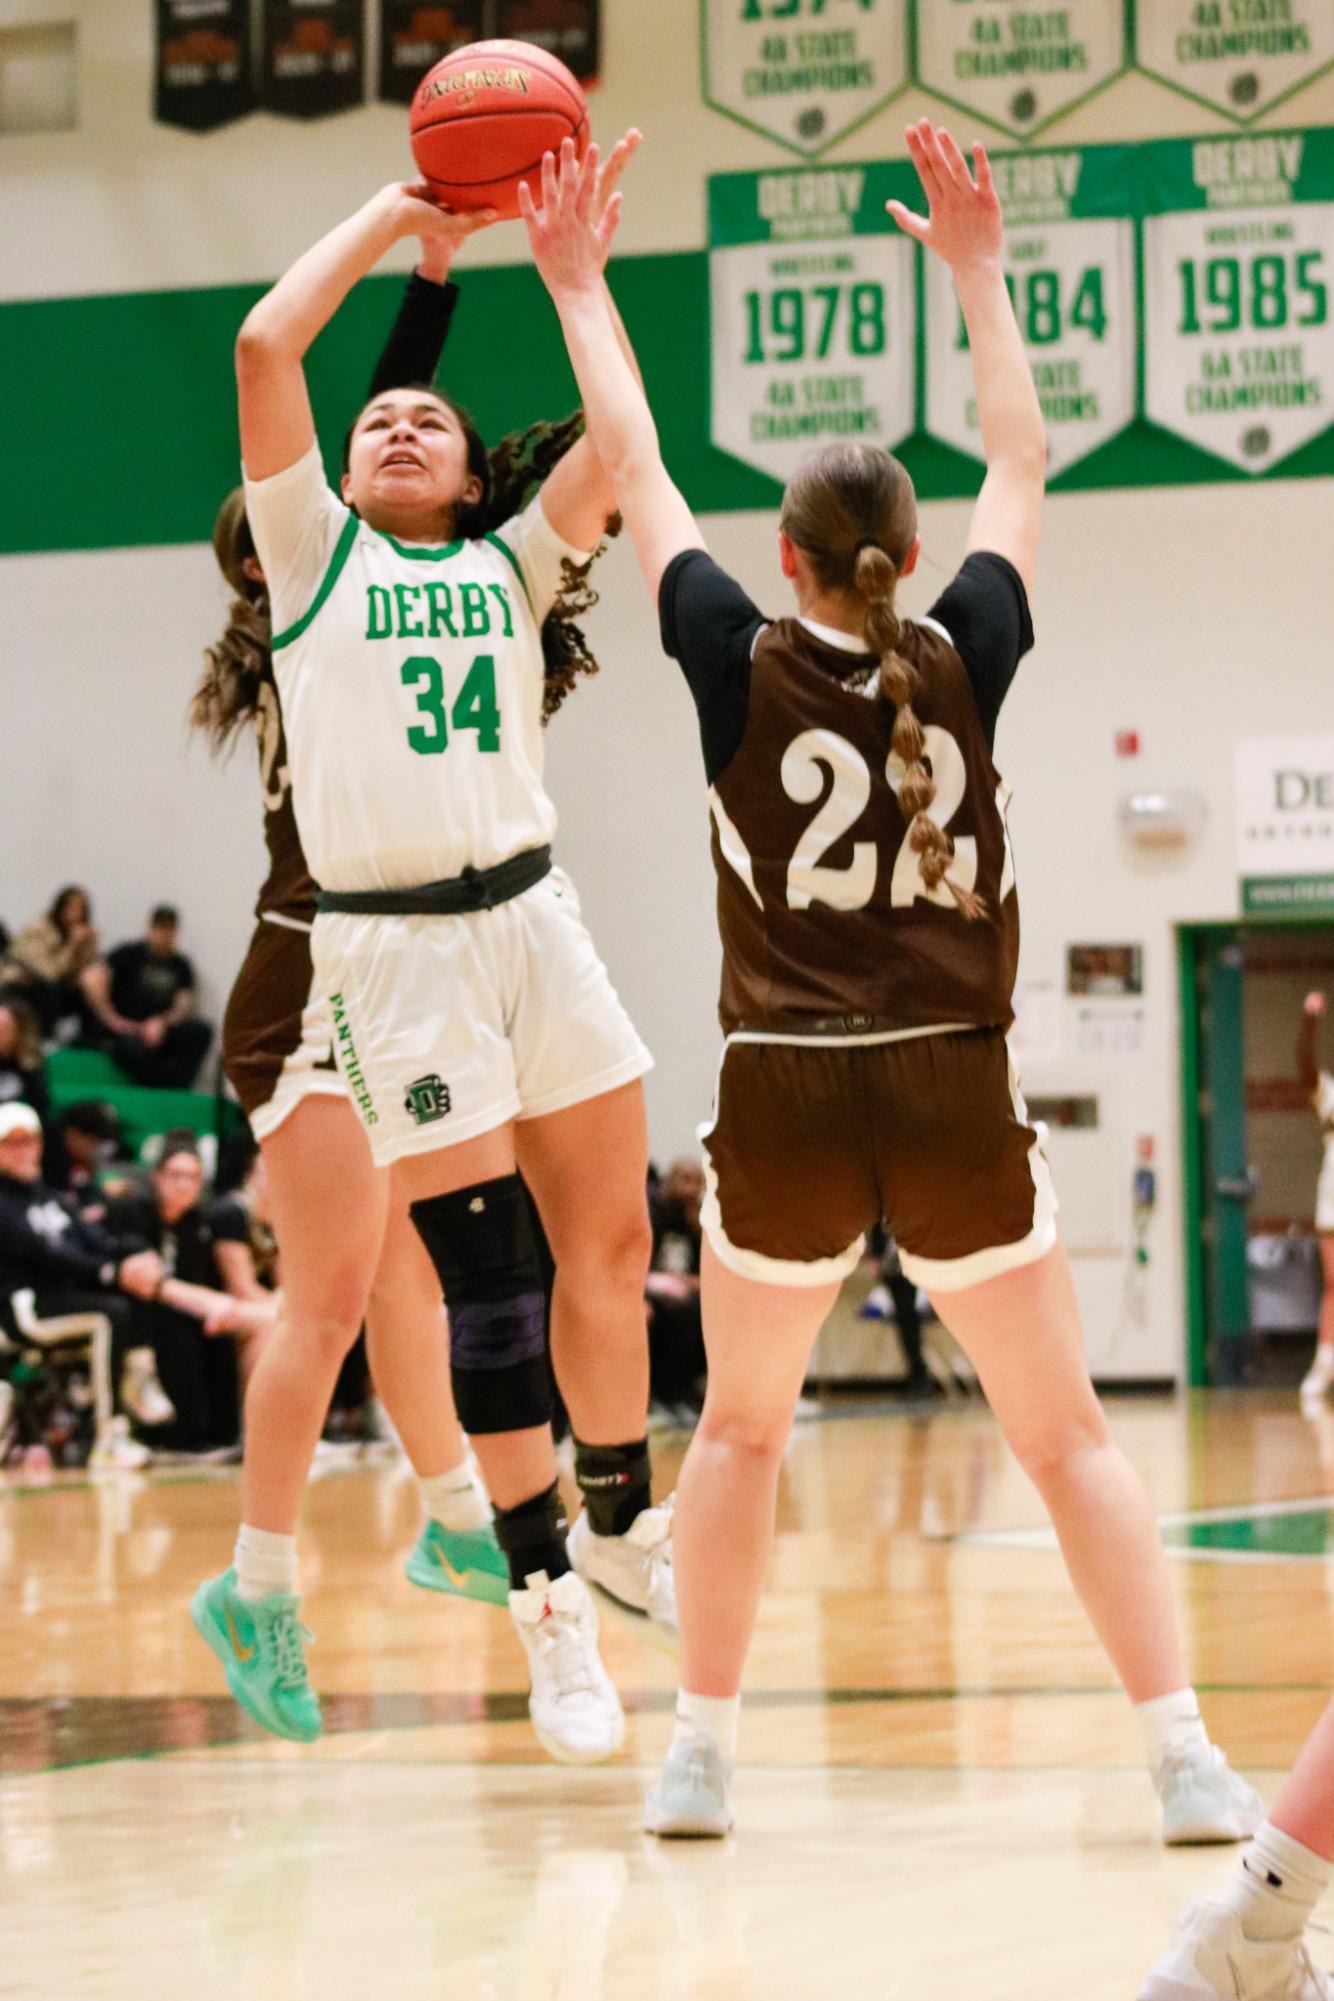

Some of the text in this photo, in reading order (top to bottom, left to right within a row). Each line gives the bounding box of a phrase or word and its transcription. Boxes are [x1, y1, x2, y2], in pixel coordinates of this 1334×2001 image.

[744, 283, 885, 364] 1978
[1178, 250, 1328, 334] 1985
[1185, 377, 1321, 416] CHAMPIONS
[1238, 346, 1302, 376] STATE
[365, 581, 514, 640] DERBY
[400, 655, 501, 755] 34
[780, 724, 978, 910] 22
[329, 992, 379, 1126] PANTHERS
